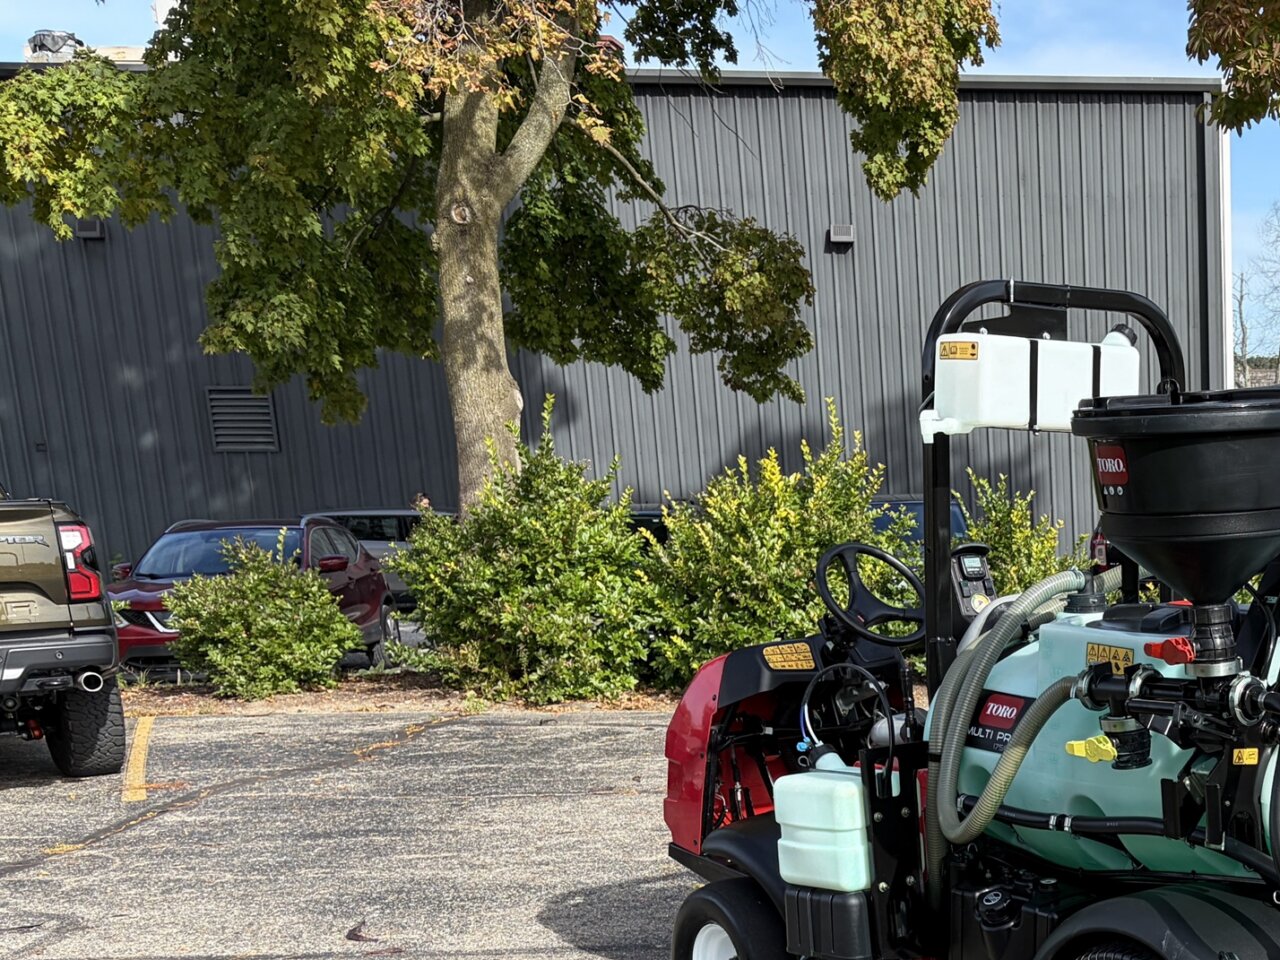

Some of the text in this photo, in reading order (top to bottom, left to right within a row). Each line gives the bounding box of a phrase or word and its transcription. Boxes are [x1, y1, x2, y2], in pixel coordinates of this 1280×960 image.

[1097, 458, 1124, 472] TORO
[986, 703, 1017, 719] TORO
[967, 726, 1012, 743] MULTI PR
[993, 742, 1005, 752] 175
